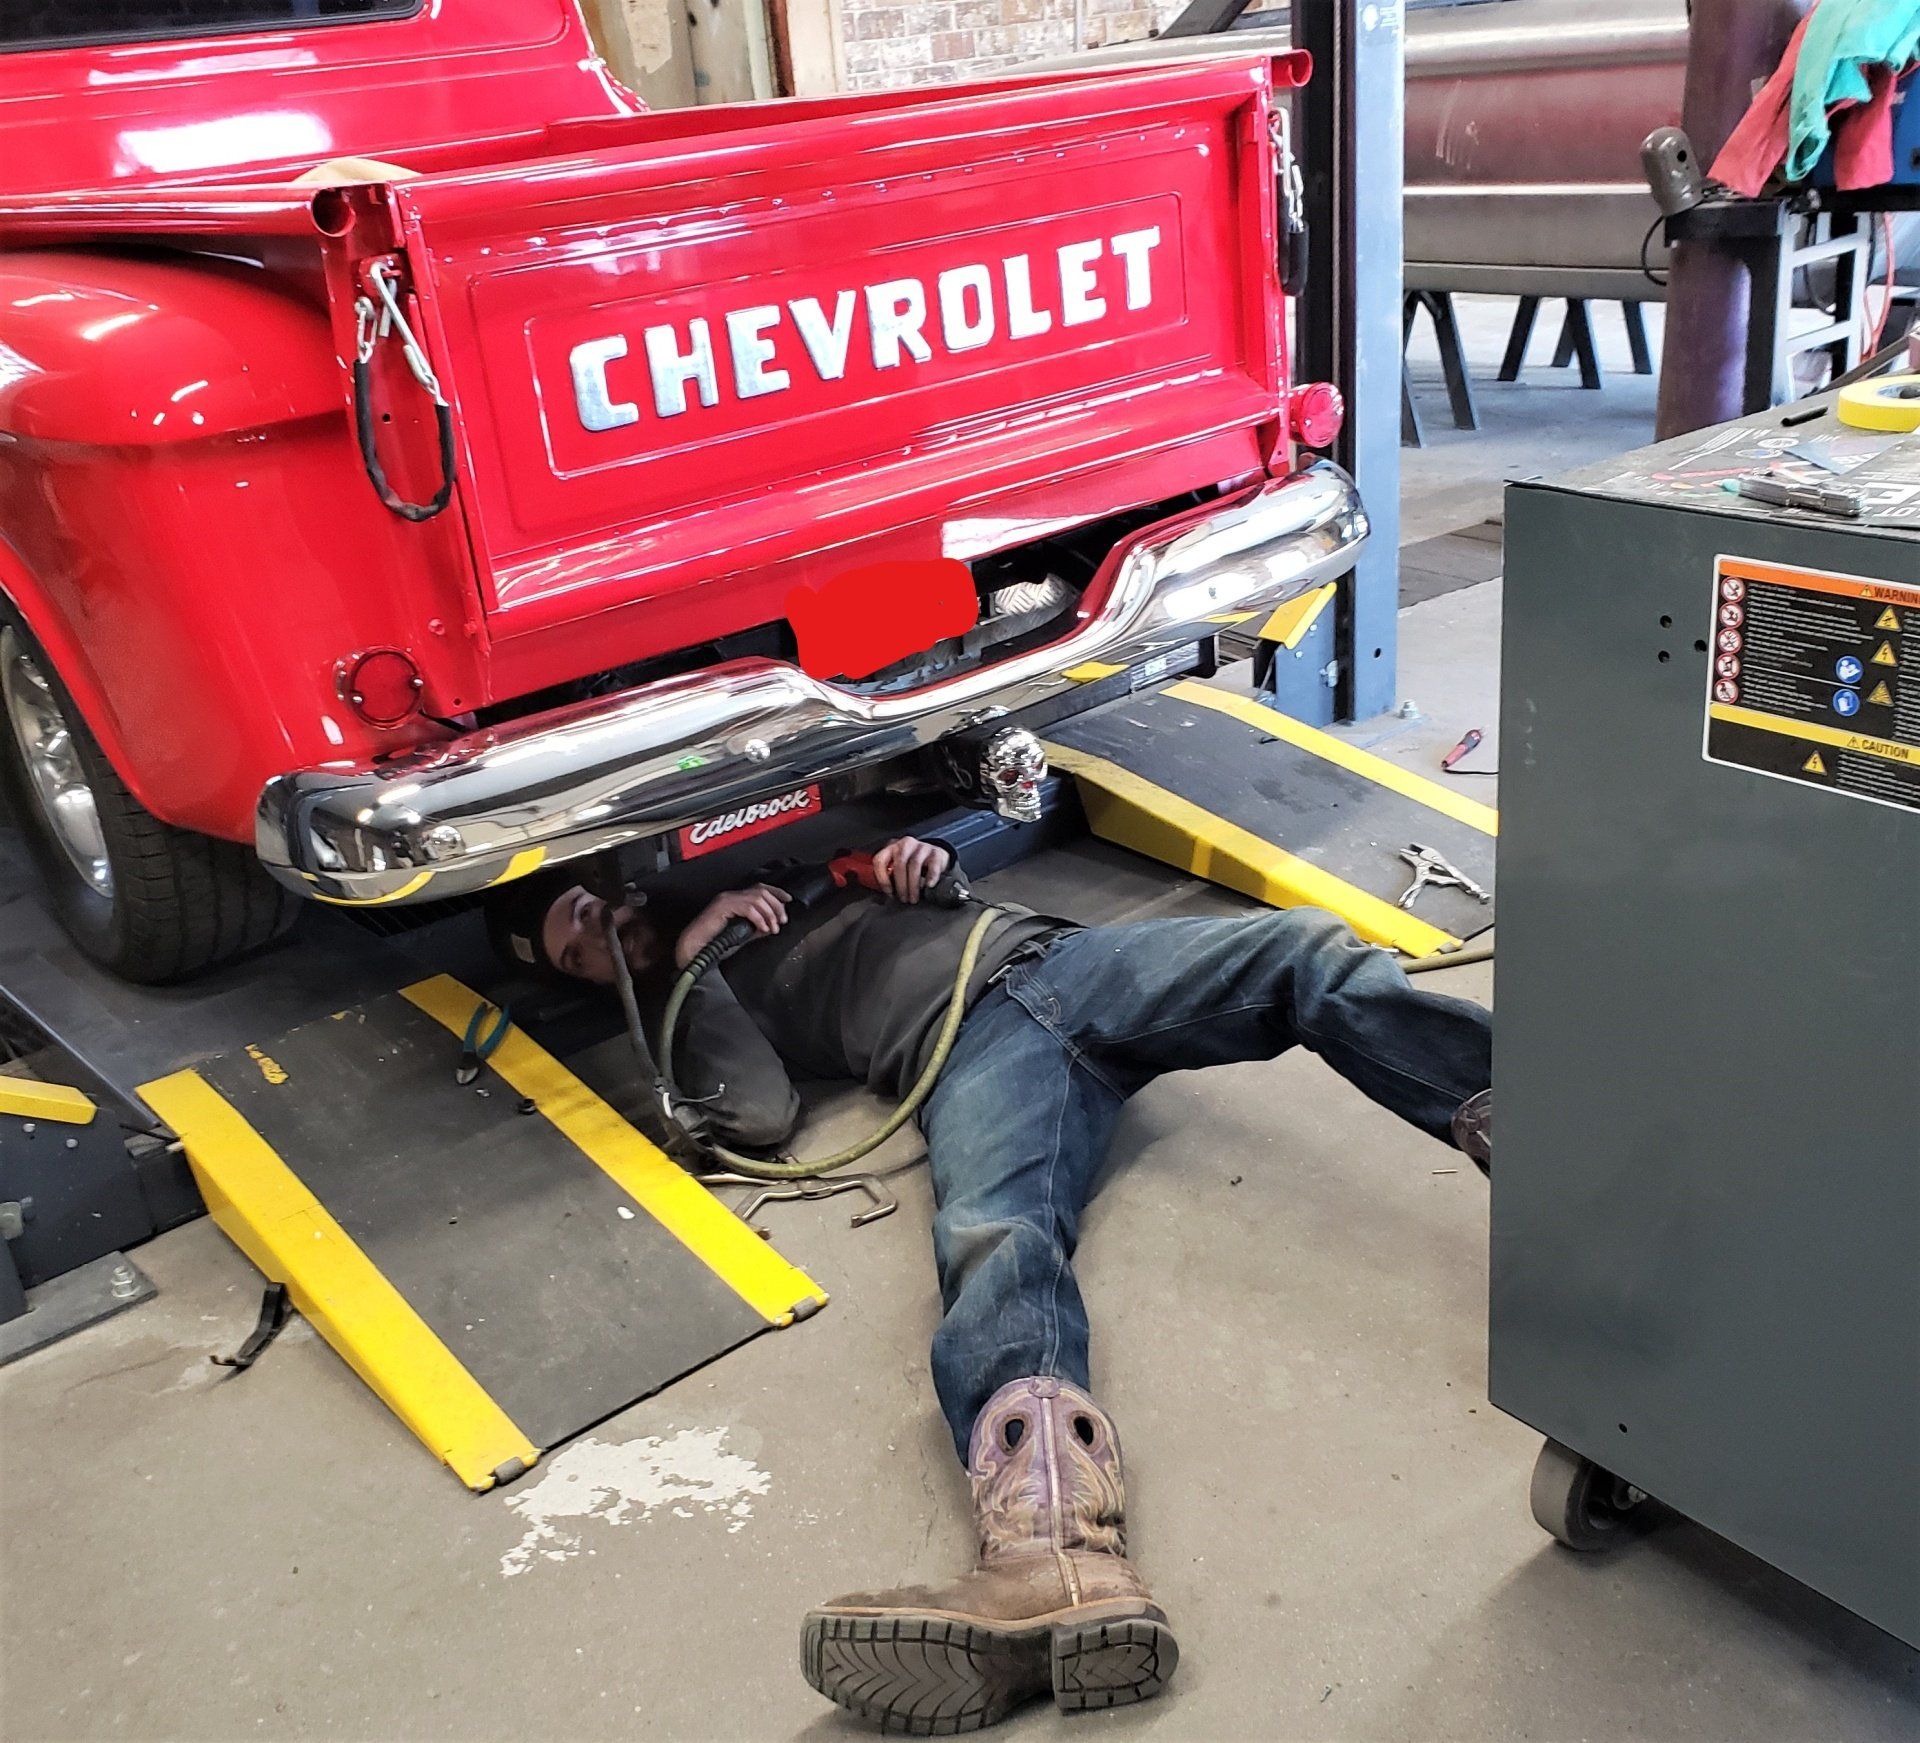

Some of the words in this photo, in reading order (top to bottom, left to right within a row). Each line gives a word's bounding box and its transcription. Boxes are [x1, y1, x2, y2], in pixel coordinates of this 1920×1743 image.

[569, 225, 1161, 432] CHEVROLET
[1874, 586, 1920, 604] WARNIN
[1861, 739, 1909, 760] CAUTION
[689, 789, 811, 844] Edelbrock
